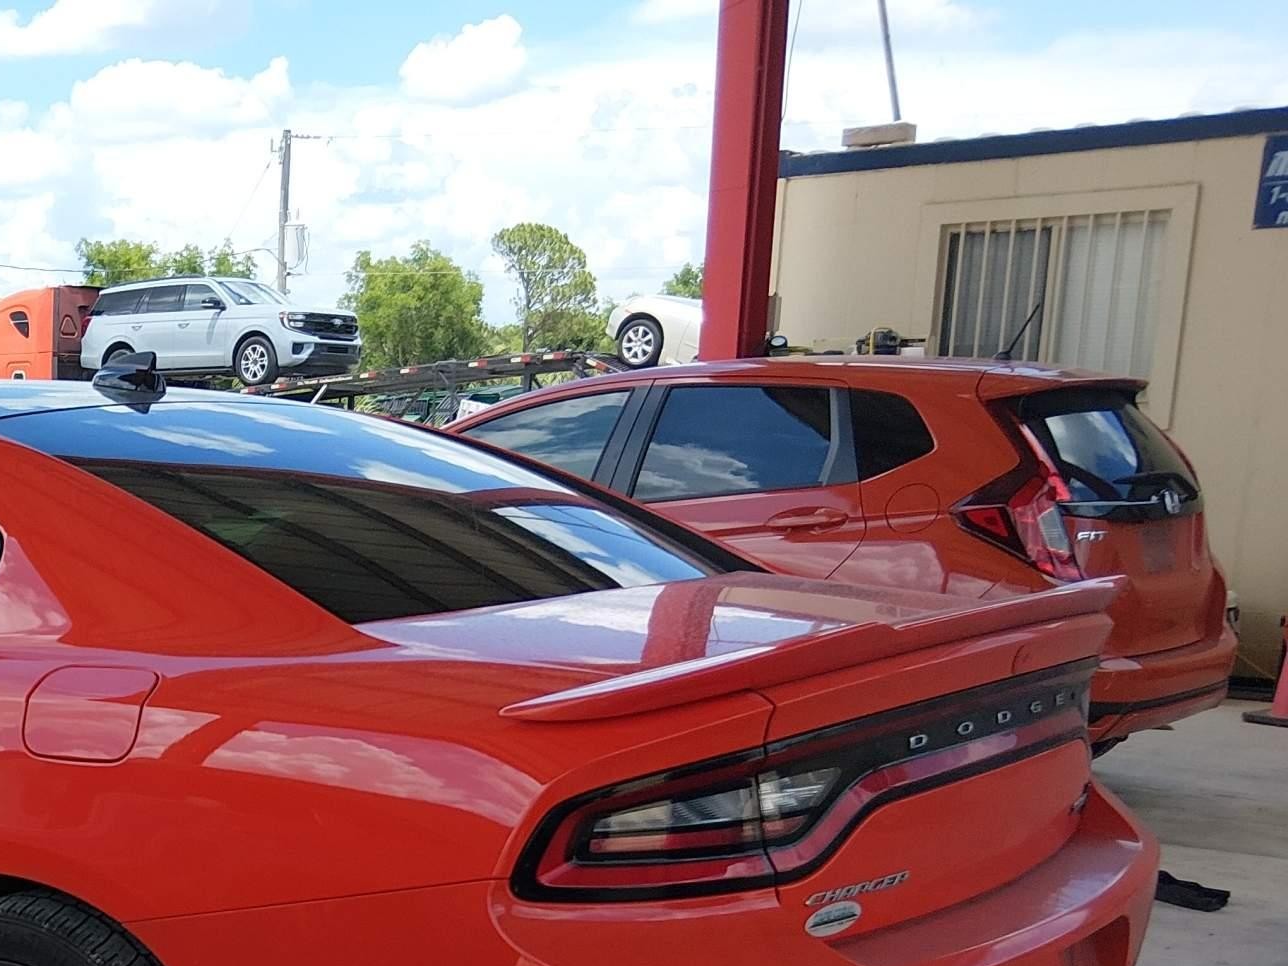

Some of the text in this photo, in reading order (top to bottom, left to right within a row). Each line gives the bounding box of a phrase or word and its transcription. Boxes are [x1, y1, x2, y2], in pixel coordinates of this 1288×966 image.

[1076, 531, 1109, 542] FIT
[909, 692, 1065, 750] DODGE
[805, 871, 910, 906] CHARGER
